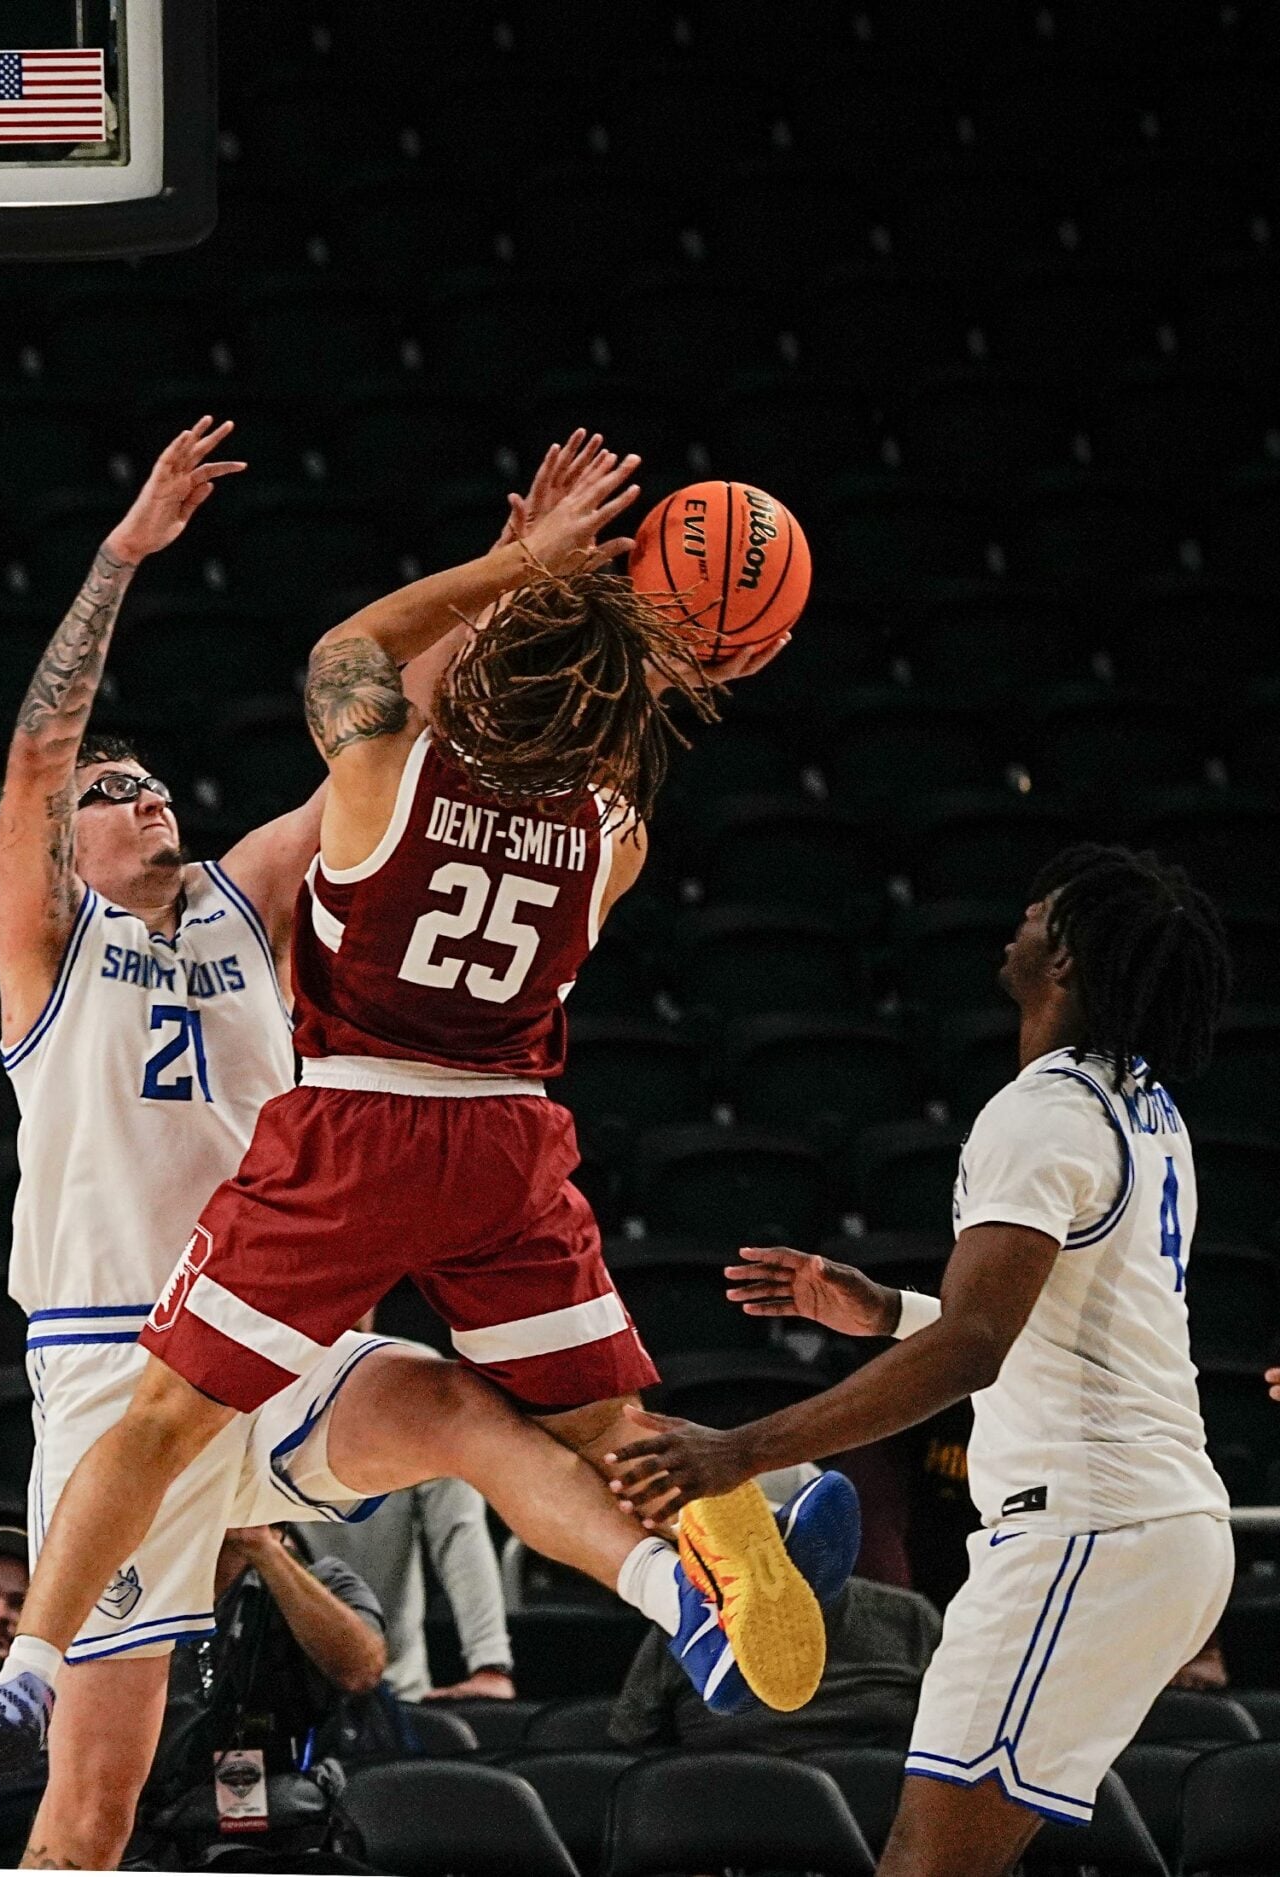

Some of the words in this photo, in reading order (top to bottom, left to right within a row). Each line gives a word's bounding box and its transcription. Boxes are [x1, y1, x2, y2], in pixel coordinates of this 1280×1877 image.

[736, 489, 778, 589] Wilson
[425, 796, 587, 872] DENT-SMITH
[397, 861, 561, 1005] 25
[140, 1004, 214, 1103] 21
[1159, 1156, 1186, 1293] 4
